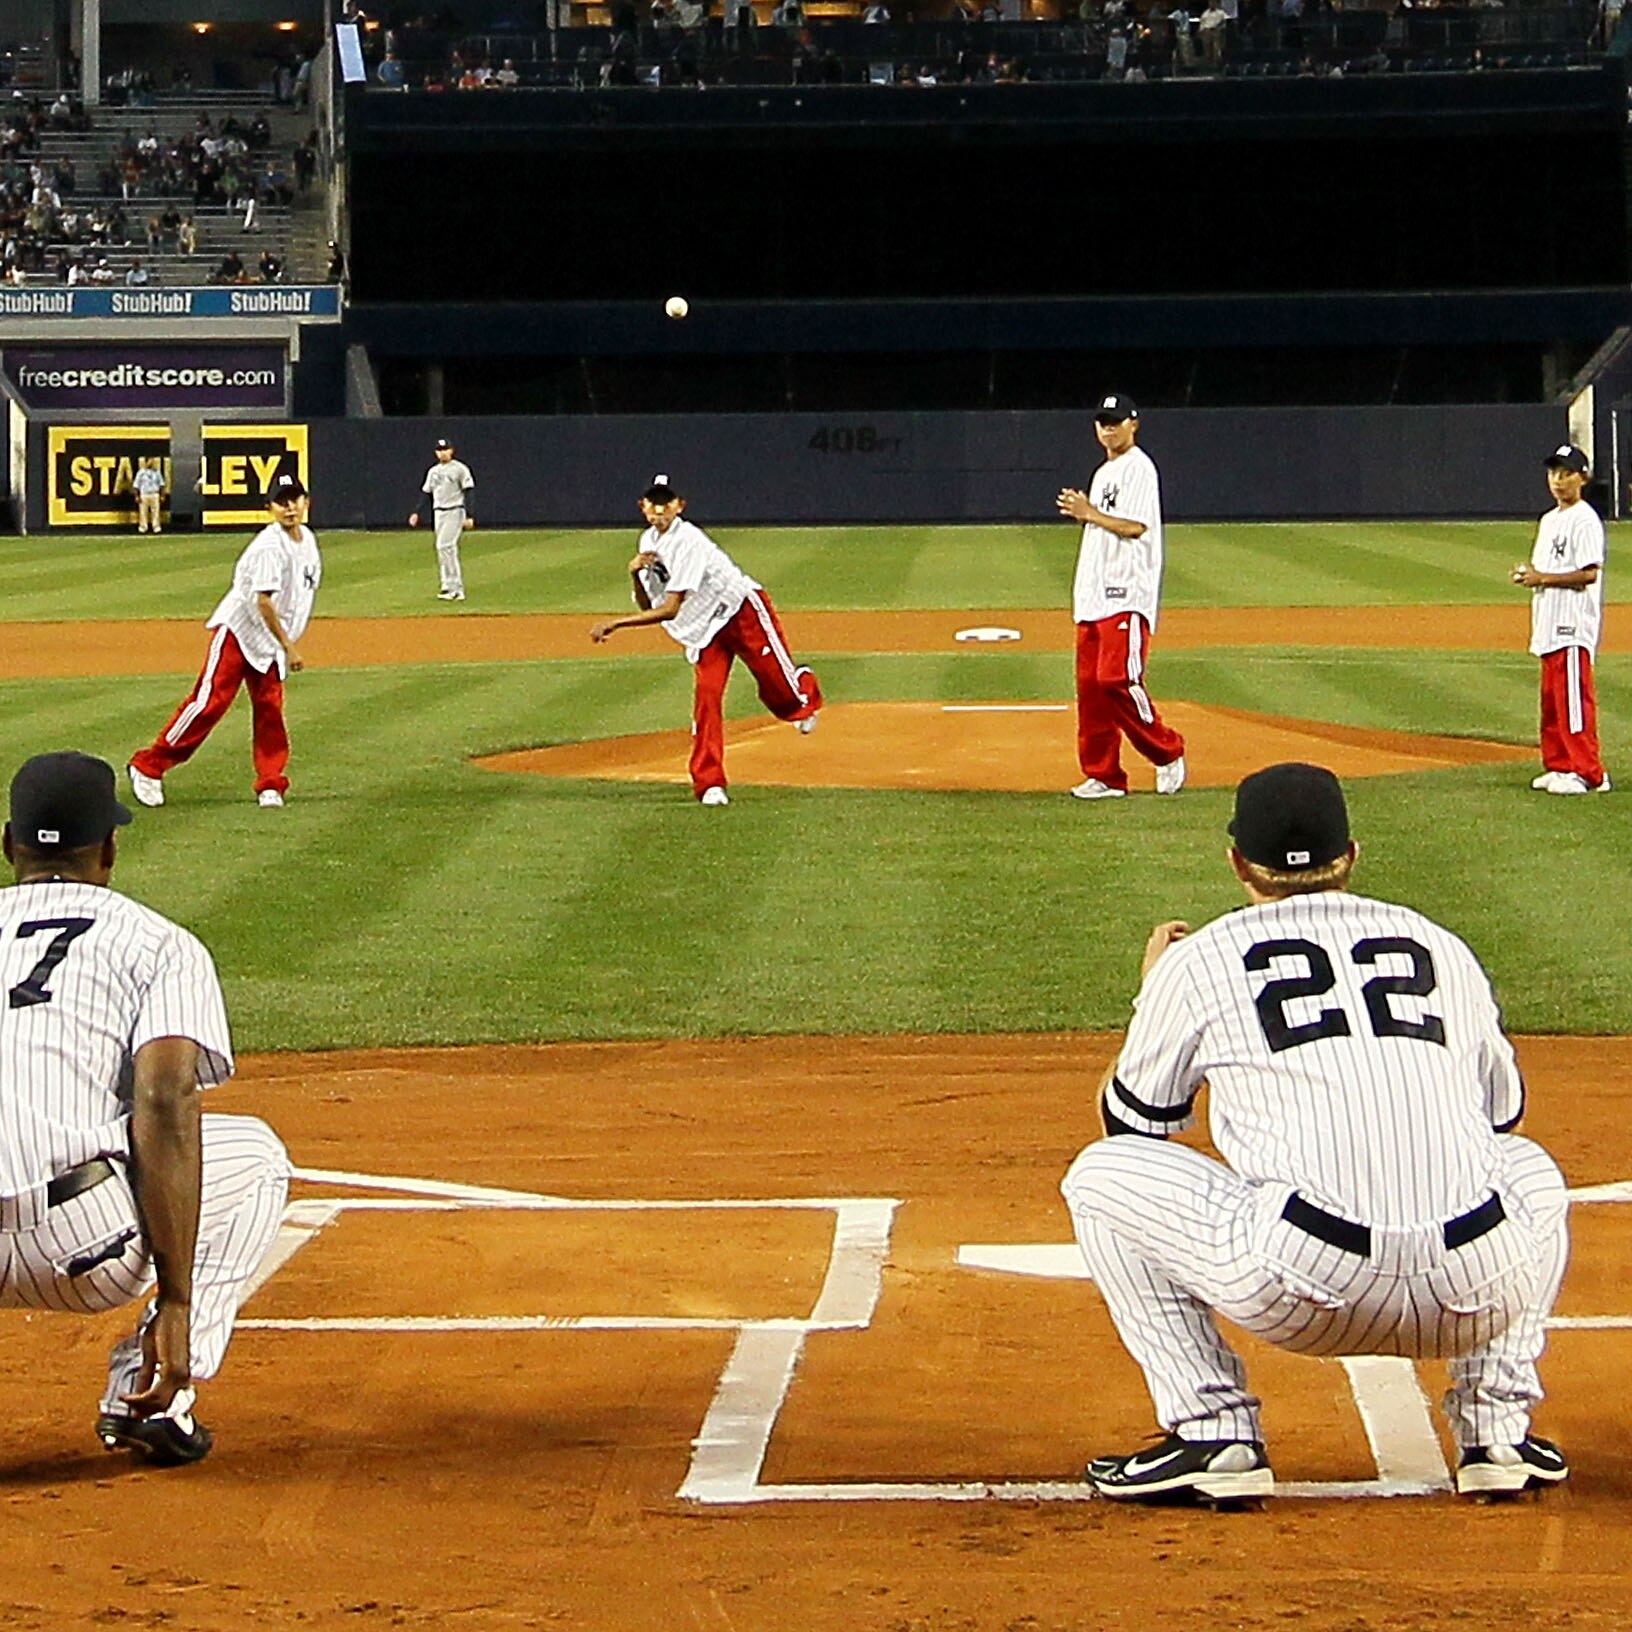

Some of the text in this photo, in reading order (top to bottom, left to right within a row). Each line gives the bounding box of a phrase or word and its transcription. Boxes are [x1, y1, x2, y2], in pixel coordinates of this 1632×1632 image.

[112, 292, 192, 313] StubHub!
[231, 292, 311, 312] StubHub!
[19, 365, 275, 388] freecreditscore.com
[1242, 937, 1448, 1053] 22
